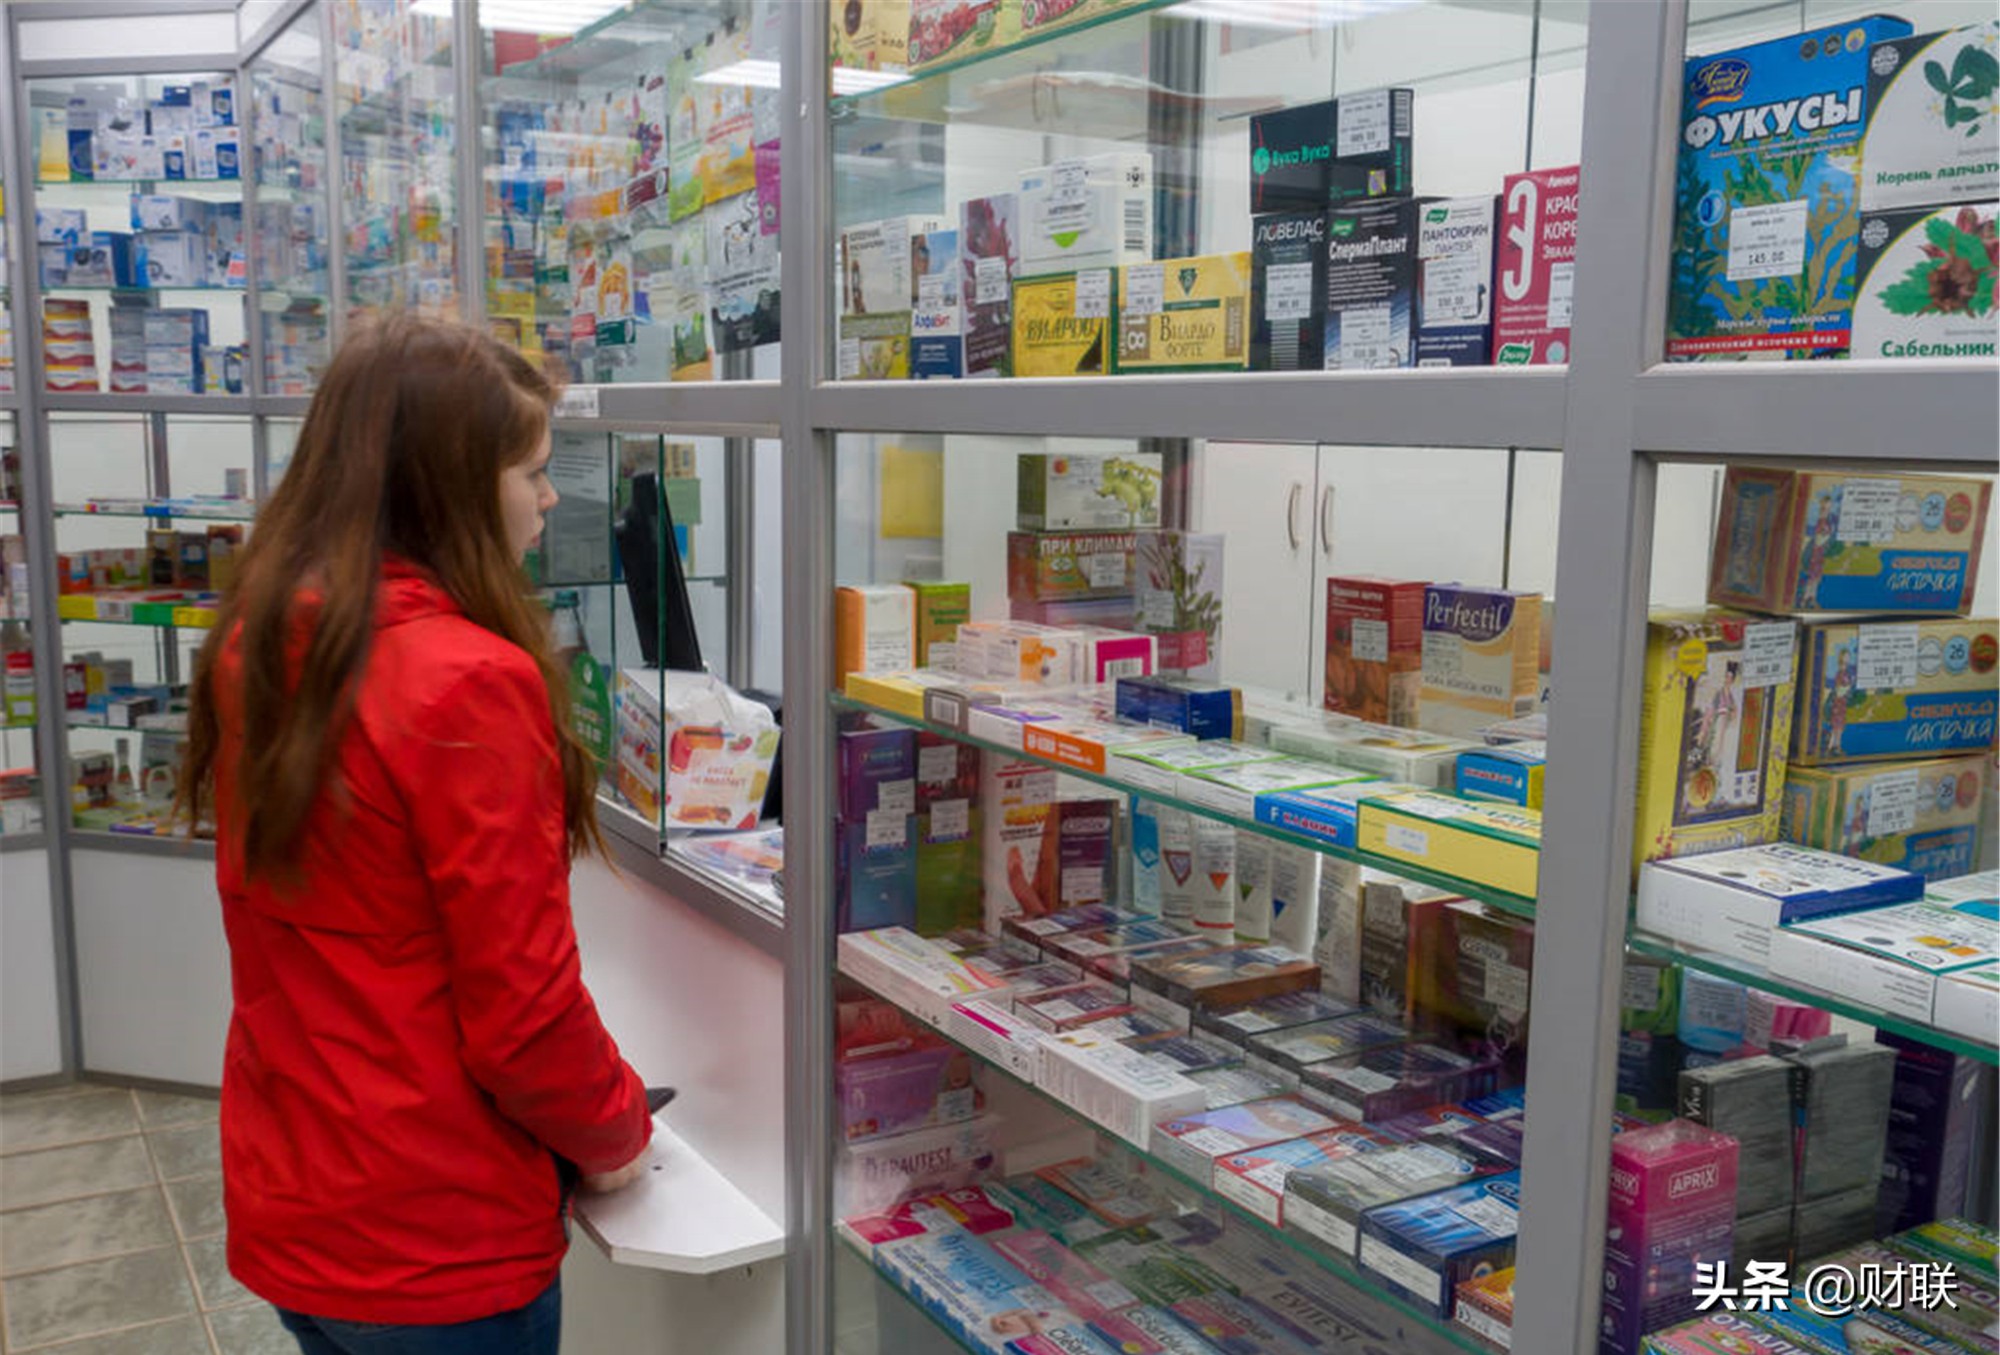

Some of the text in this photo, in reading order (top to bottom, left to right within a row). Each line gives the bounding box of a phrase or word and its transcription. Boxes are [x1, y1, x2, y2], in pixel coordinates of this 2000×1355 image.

[1685, 88, 1863, 148] ФУКУСЫ
[1877, 171, 1932, 186] Корень
[1256, 218, 1324, 243] ЛОВЕЛАС
[1422, 224, 1488, 242] ПАНТОКРИН
[1328, 235, 1408, 263] СпермаПлант
[1041, 538, 1071, 556] ПРИ
[1425, 592, 1507, 633] Perfectil
[1949, 643, 1965, 660] 26
[1671, 1165, 1715, 1193] APRIX
